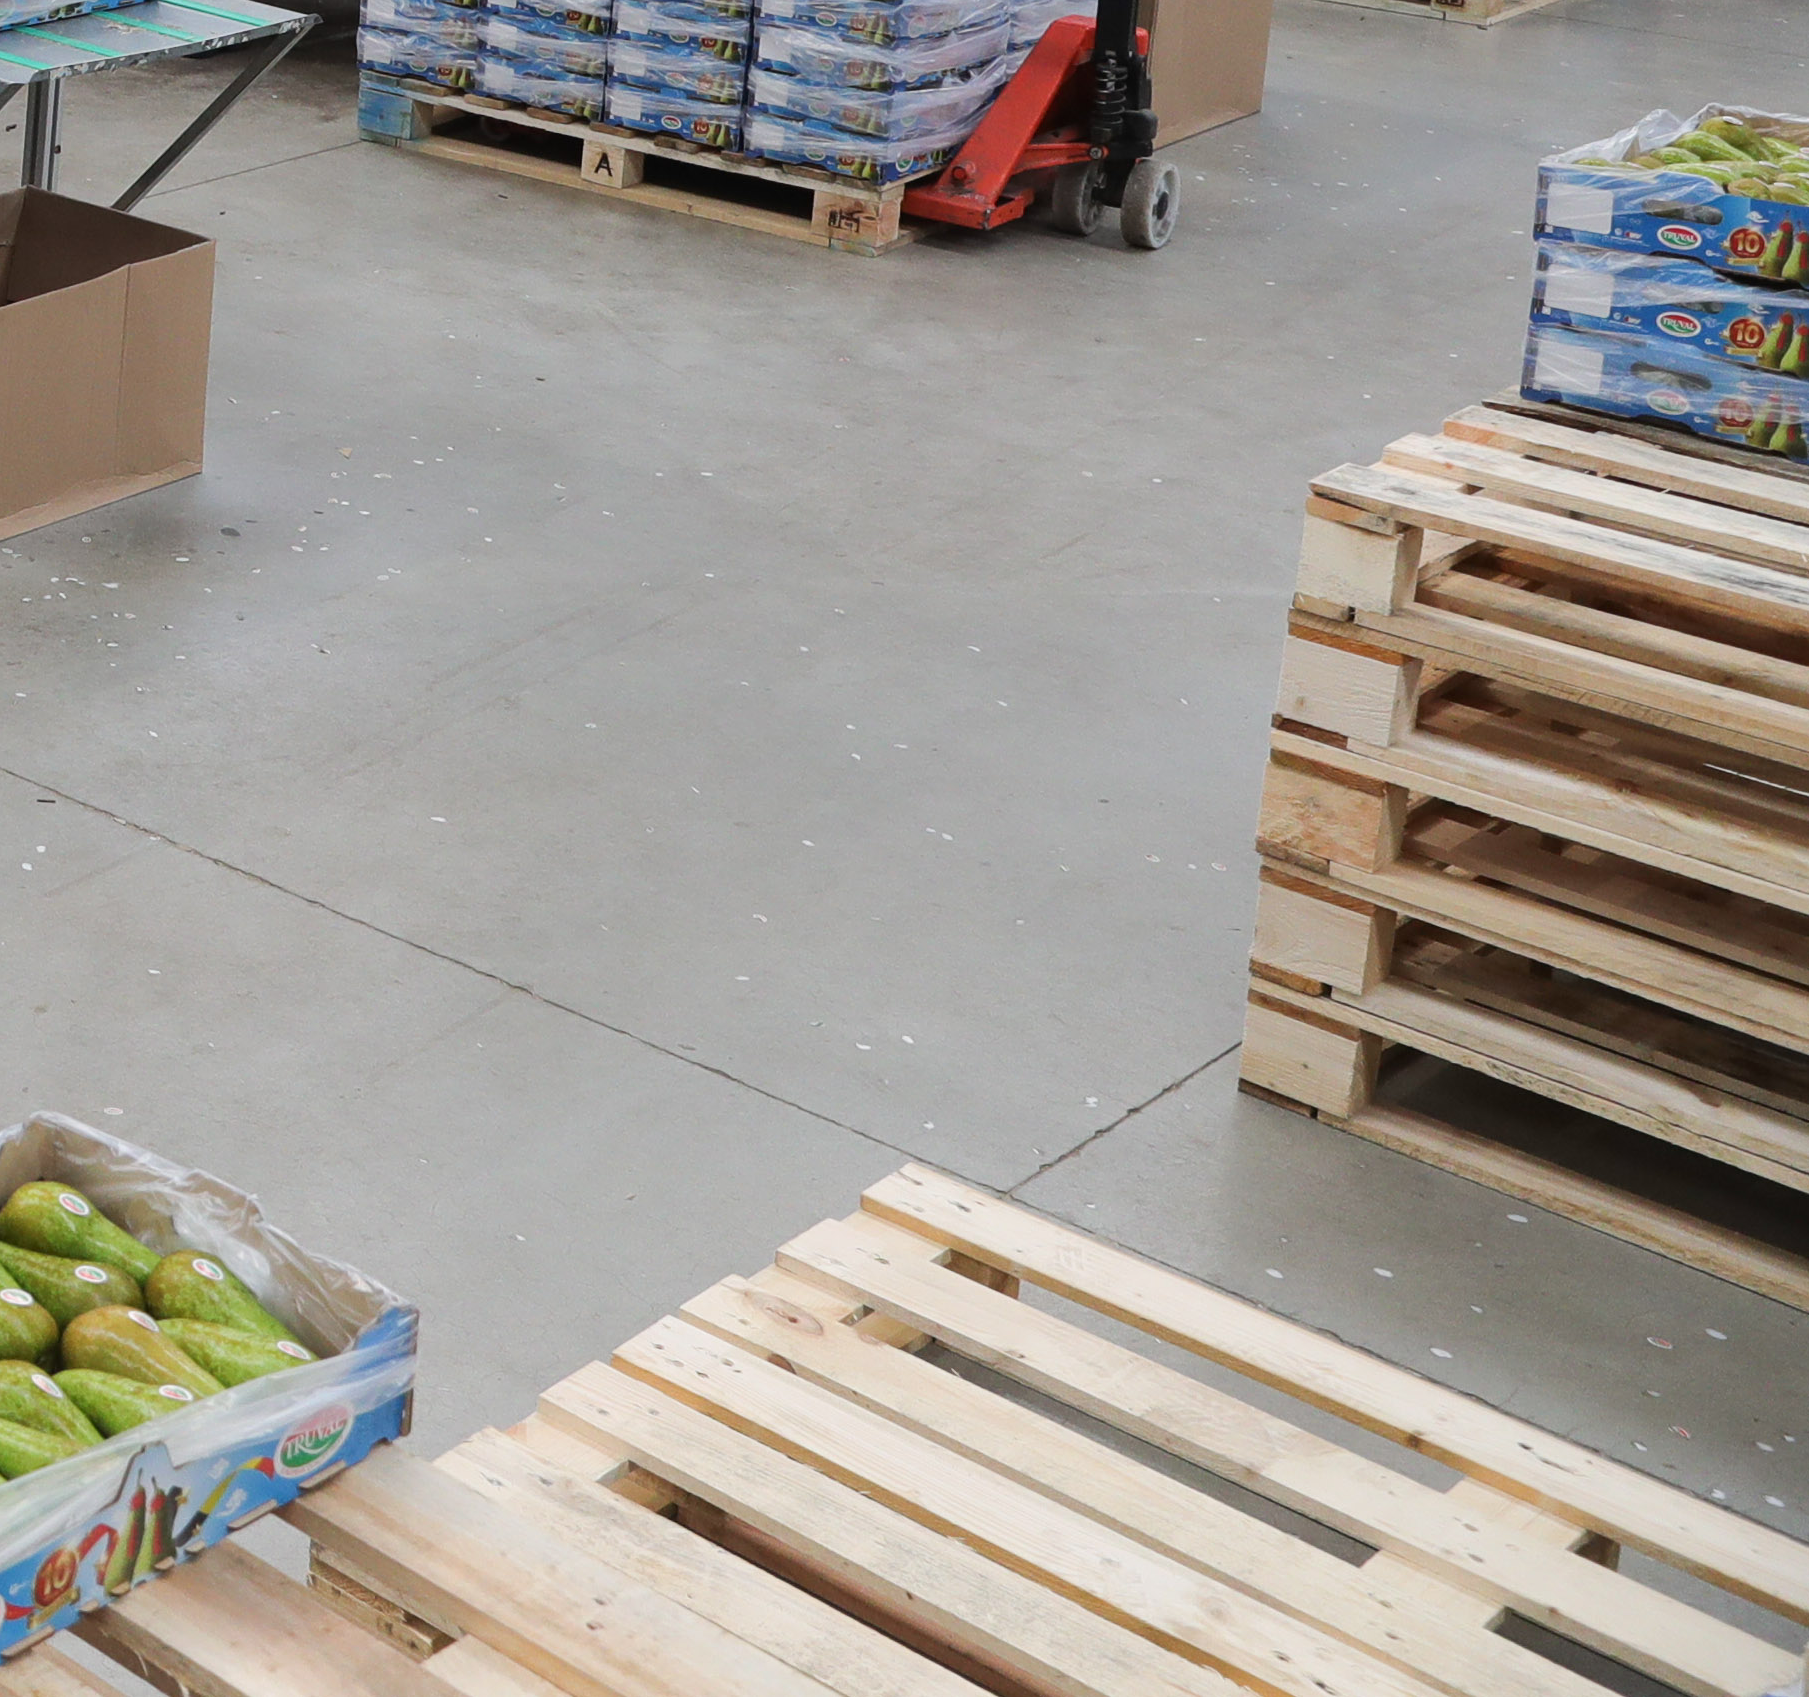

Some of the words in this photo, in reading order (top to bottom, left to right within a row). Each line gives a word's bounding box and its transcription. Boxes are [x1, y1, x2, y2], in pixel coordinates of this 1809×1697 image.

[593, 151, 614, 177] A
[1662, 229, 1699, 244] TRUVAL
[1734, 230, 1763, 253] 10
[1660, 315, 1697, 331] TRUVAL
[1733, 317, 1763, 339] 10
[284, 1418, 347, 1461] TRUVAL
[43, 1555, 75, 1597] 10
